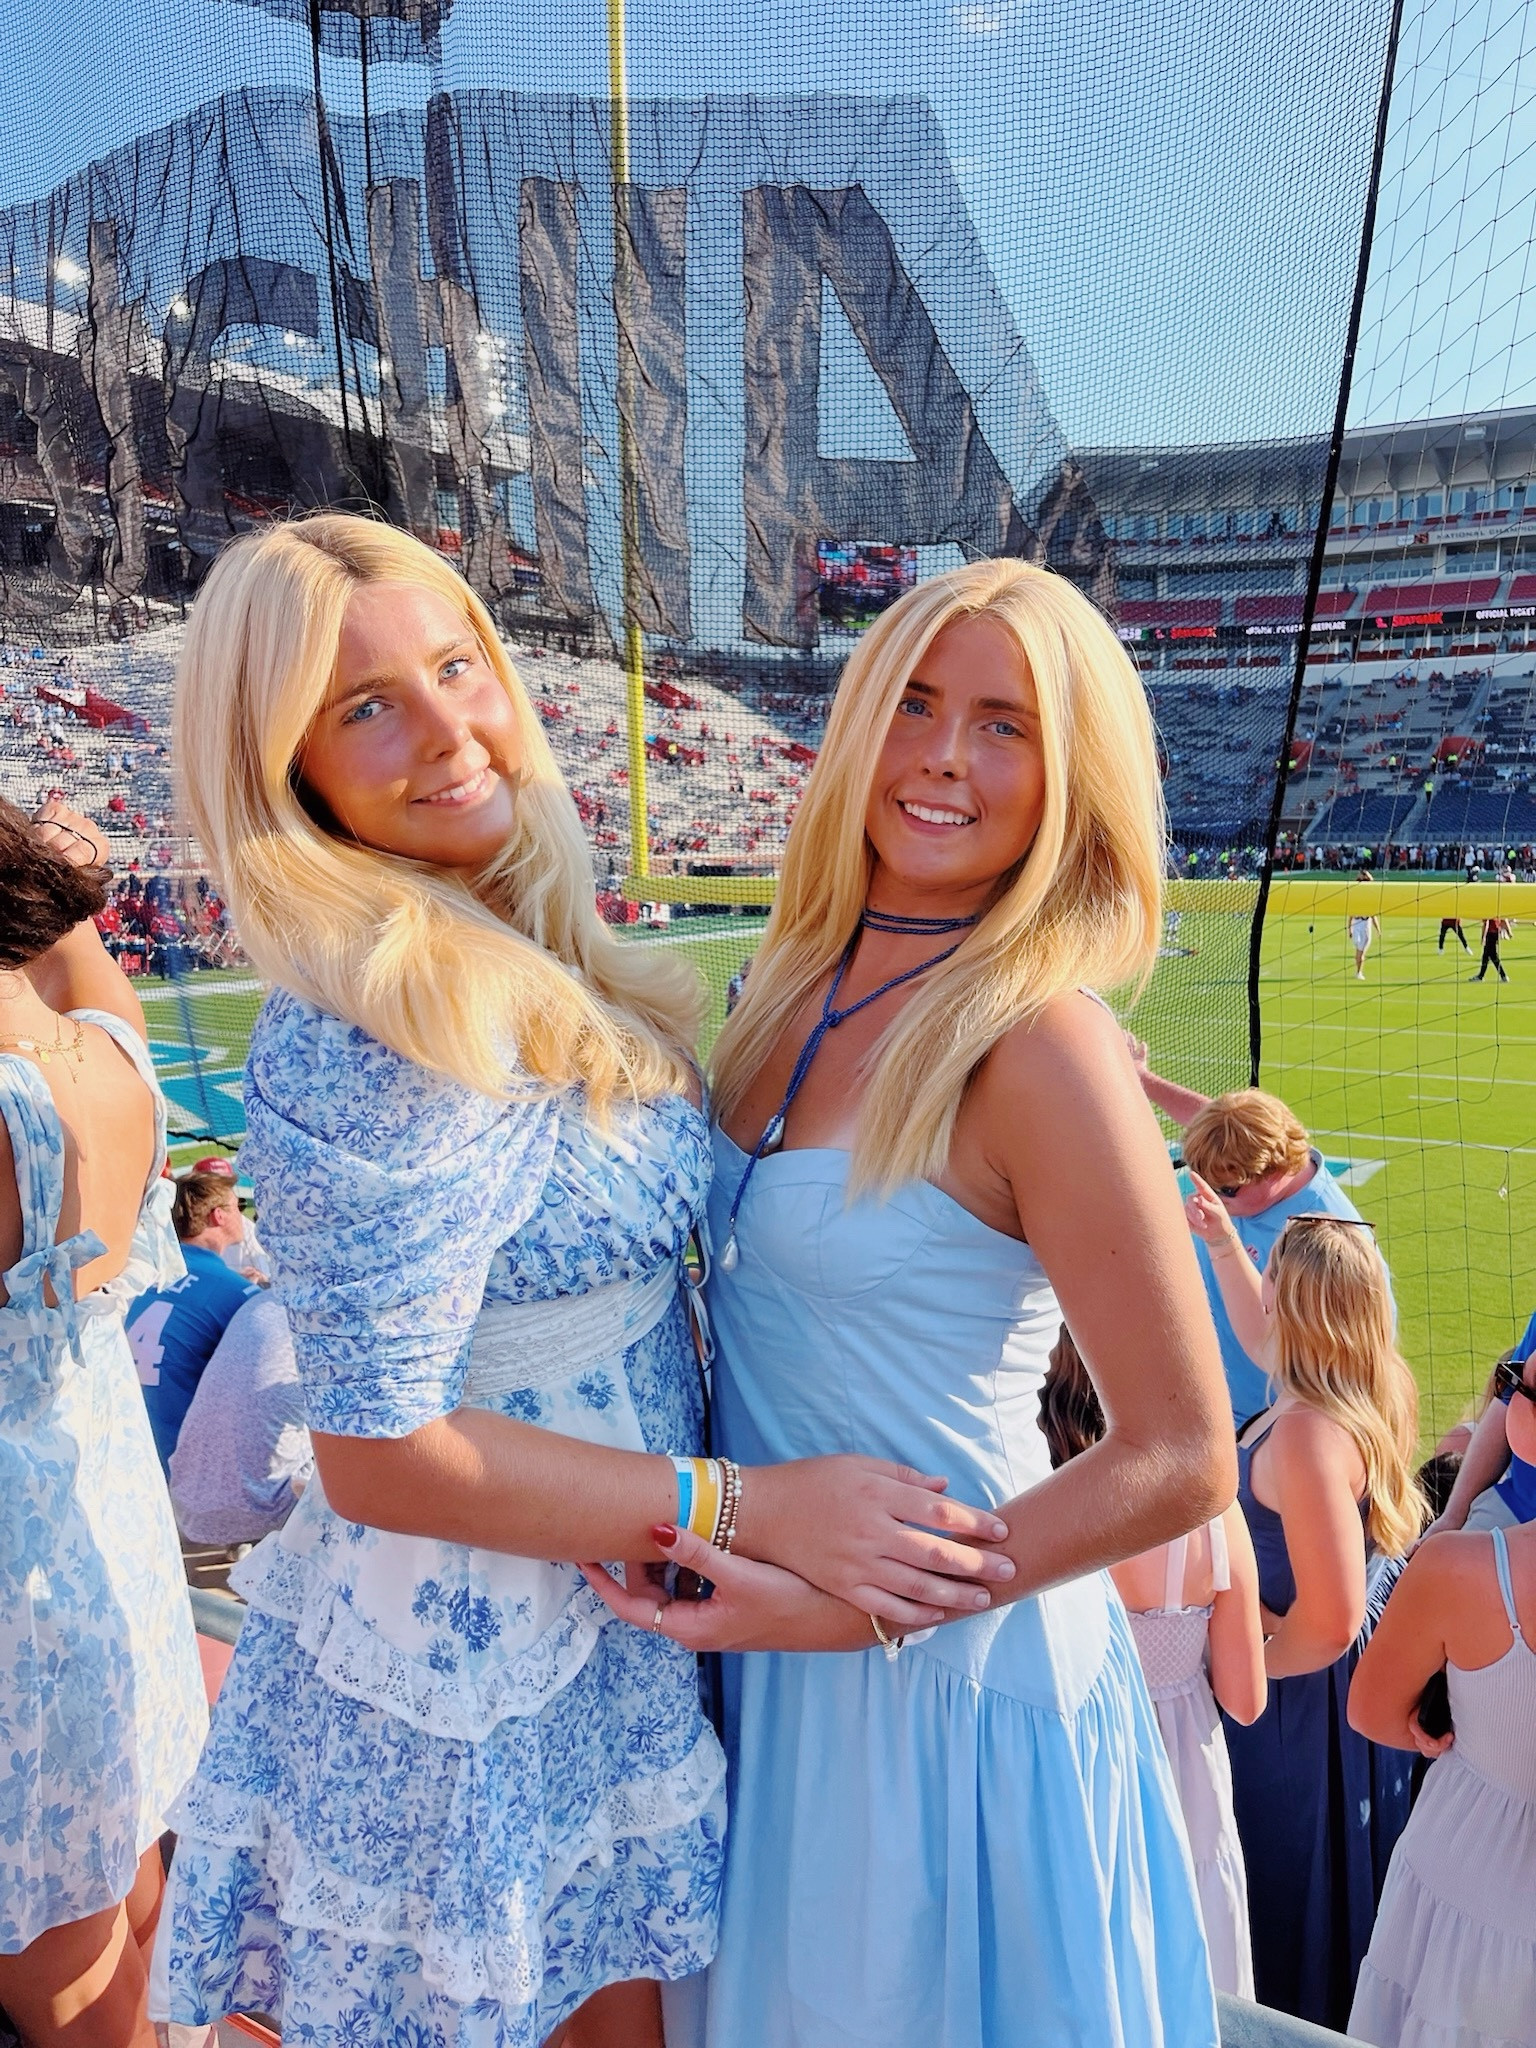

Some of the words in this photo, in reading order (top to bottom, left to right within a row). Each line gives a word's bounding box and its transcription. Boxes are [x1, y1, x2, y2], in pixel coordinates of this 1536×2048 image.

[1436, 531, 1485, 540] NATIONAL
[1476, 608, 1509, 620] OFFICIAL
[1510, 606, 1536, 618] TICKET
